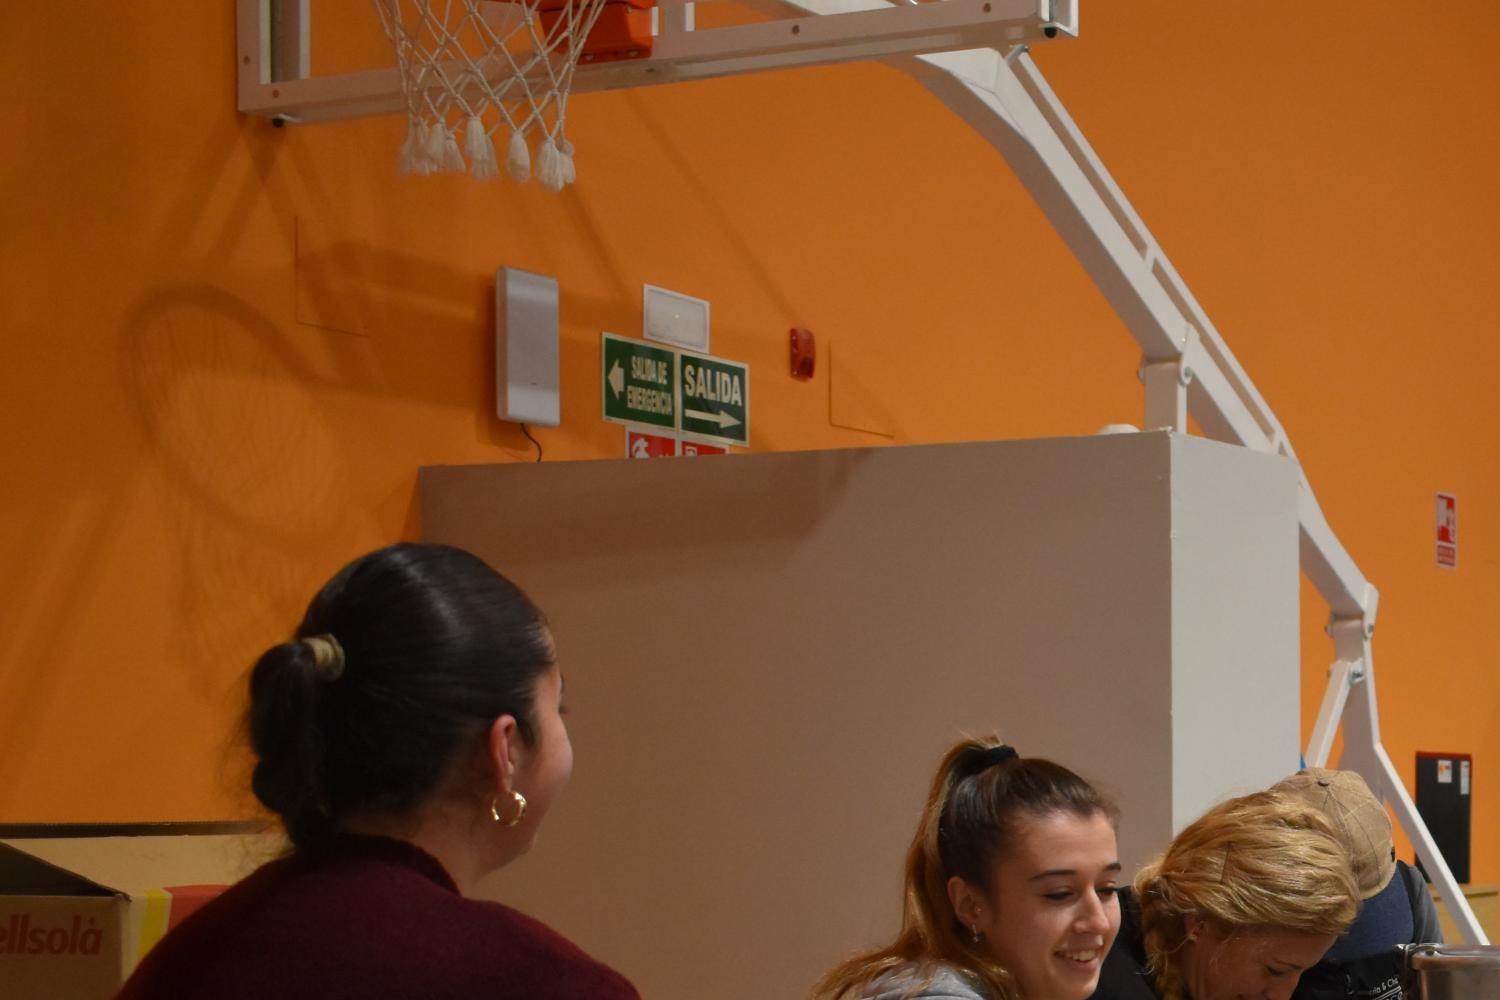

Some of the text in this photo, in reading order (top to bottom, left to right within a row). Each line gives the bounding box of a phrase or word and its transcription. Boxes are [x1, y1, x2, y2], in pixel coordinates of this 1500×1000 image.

[632, 356, 668, 385] SALIDA DE
[684, 364, 743, 407] SALIDA
[626, 385, 673, 416] EMERGENCIA
